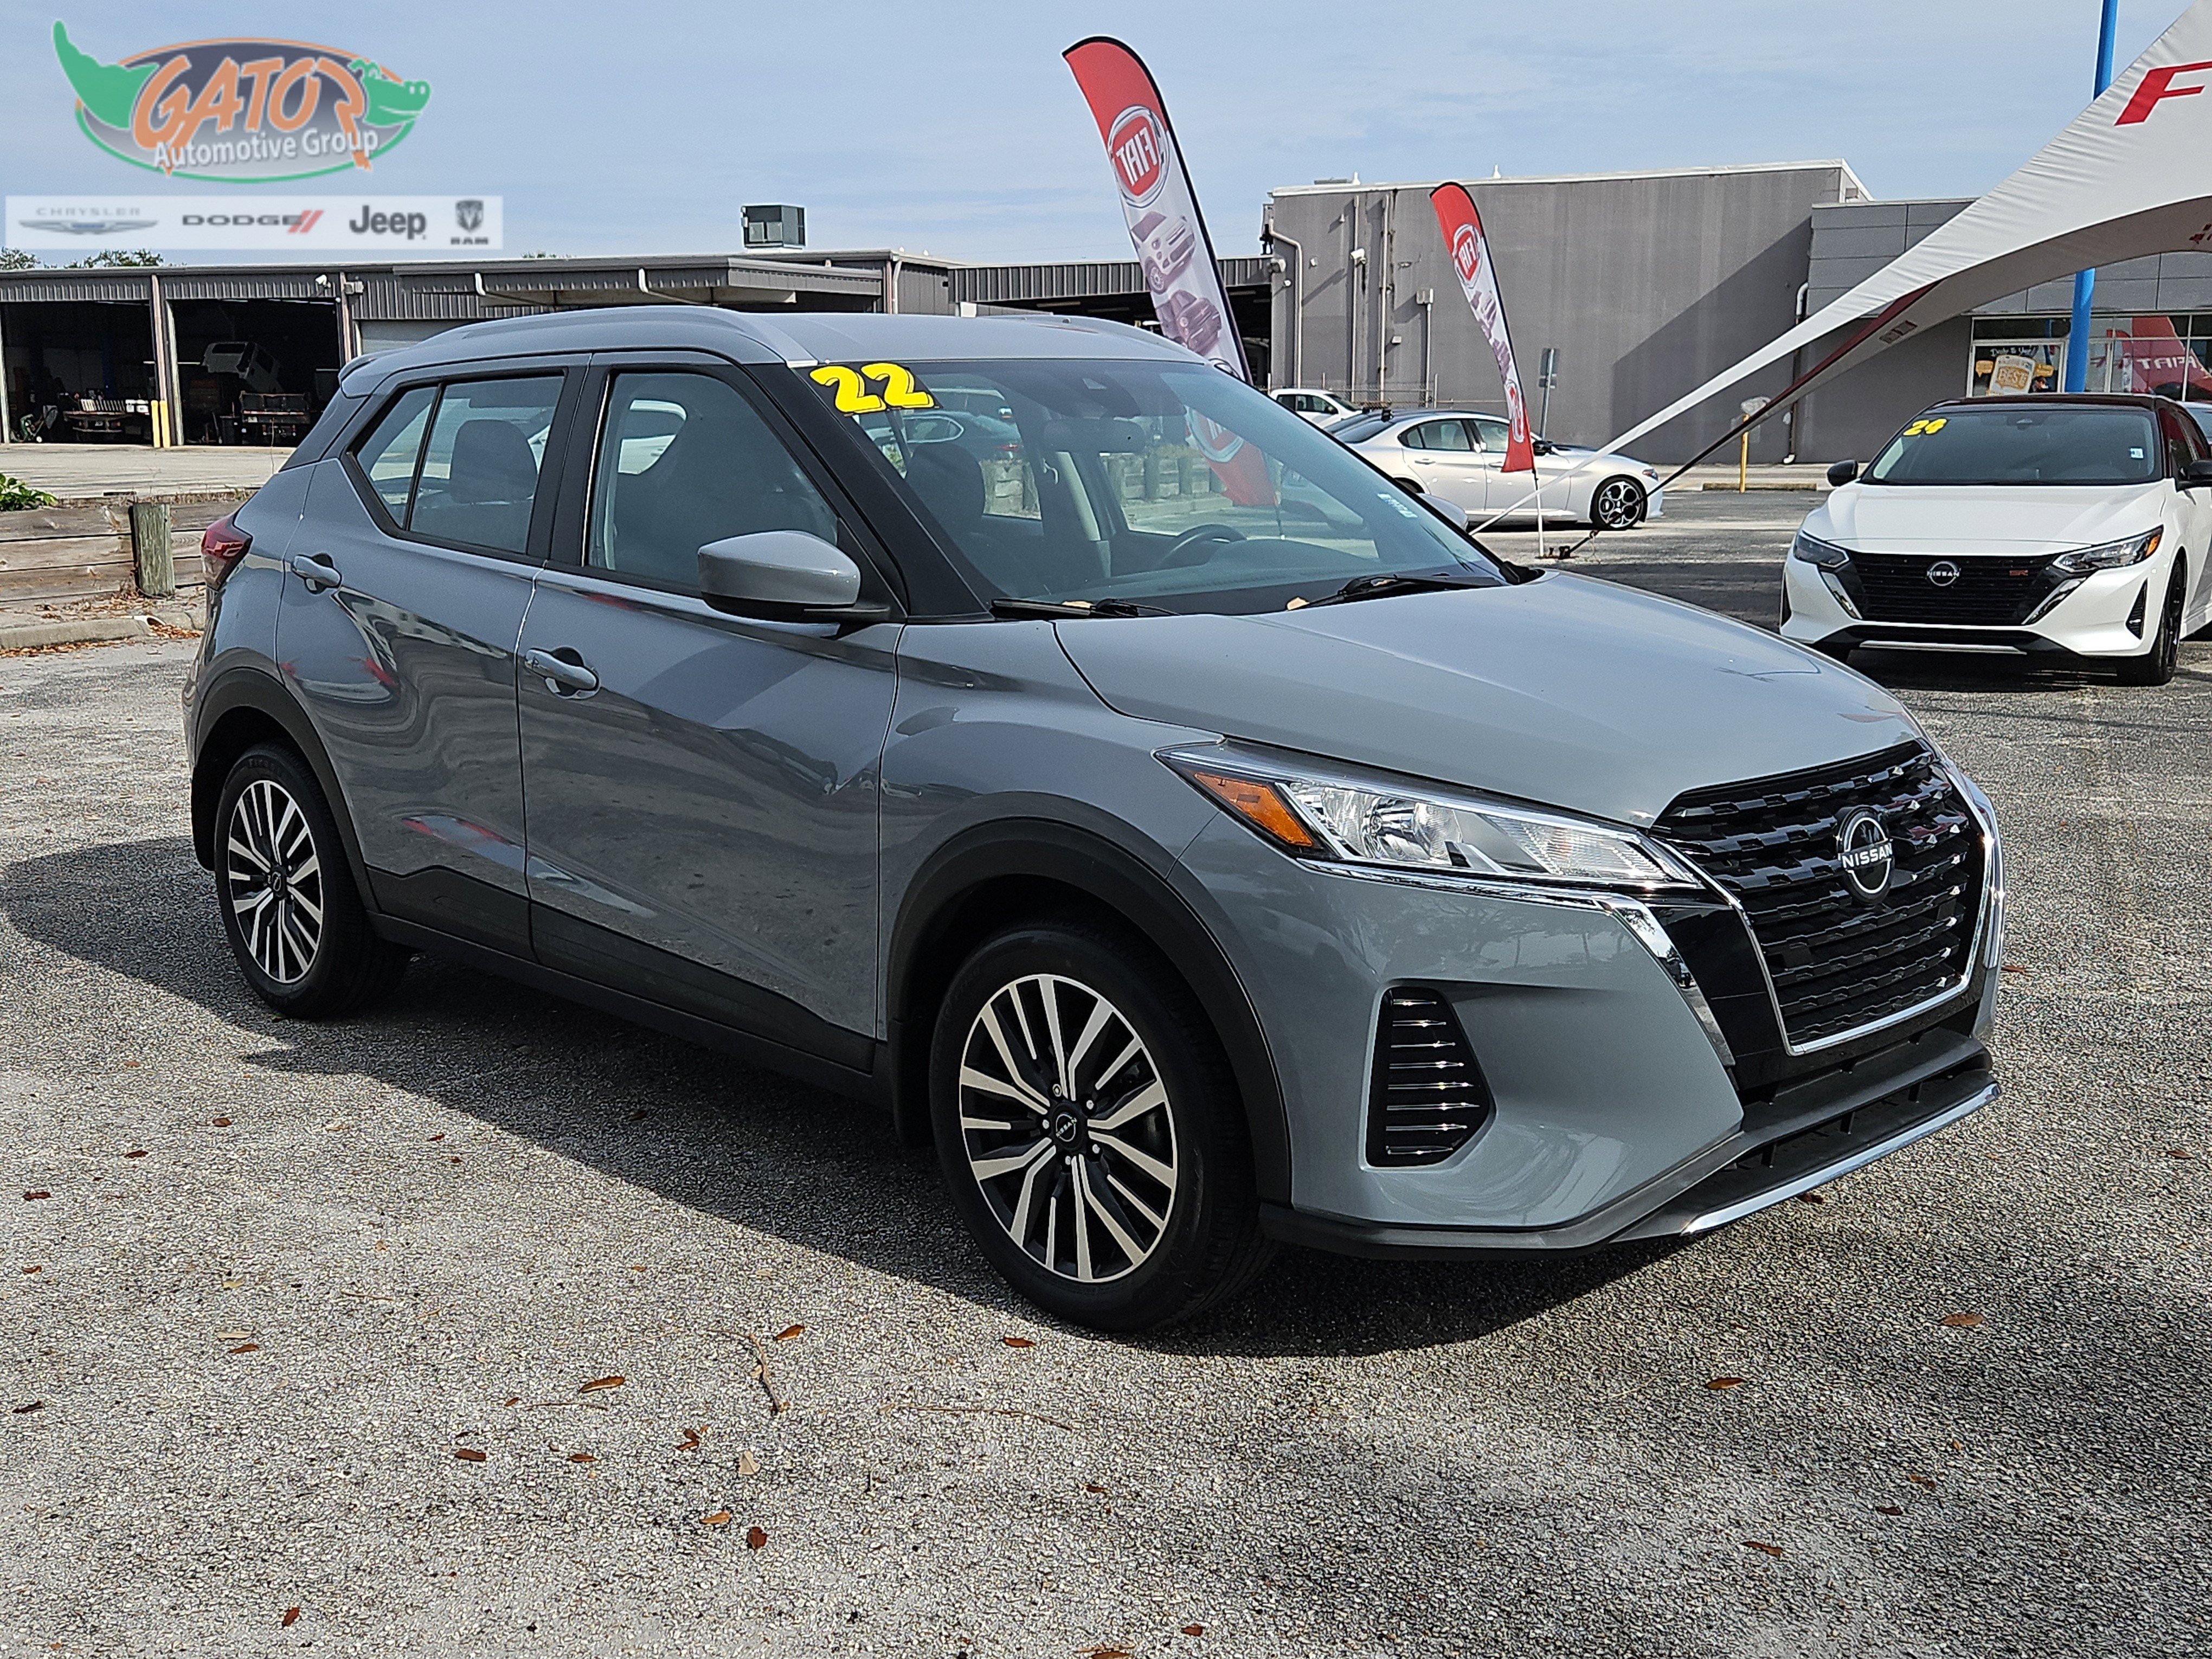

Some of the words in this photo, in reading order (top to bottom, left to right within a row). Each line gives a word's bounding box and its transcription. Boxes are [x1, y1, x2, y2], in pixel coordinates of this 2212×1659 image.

[810, 363, 935, 414] 22
[1842, 843, 1893, 869] NISSAN
[1056, 1117, 1077, 1137] NISSAN
